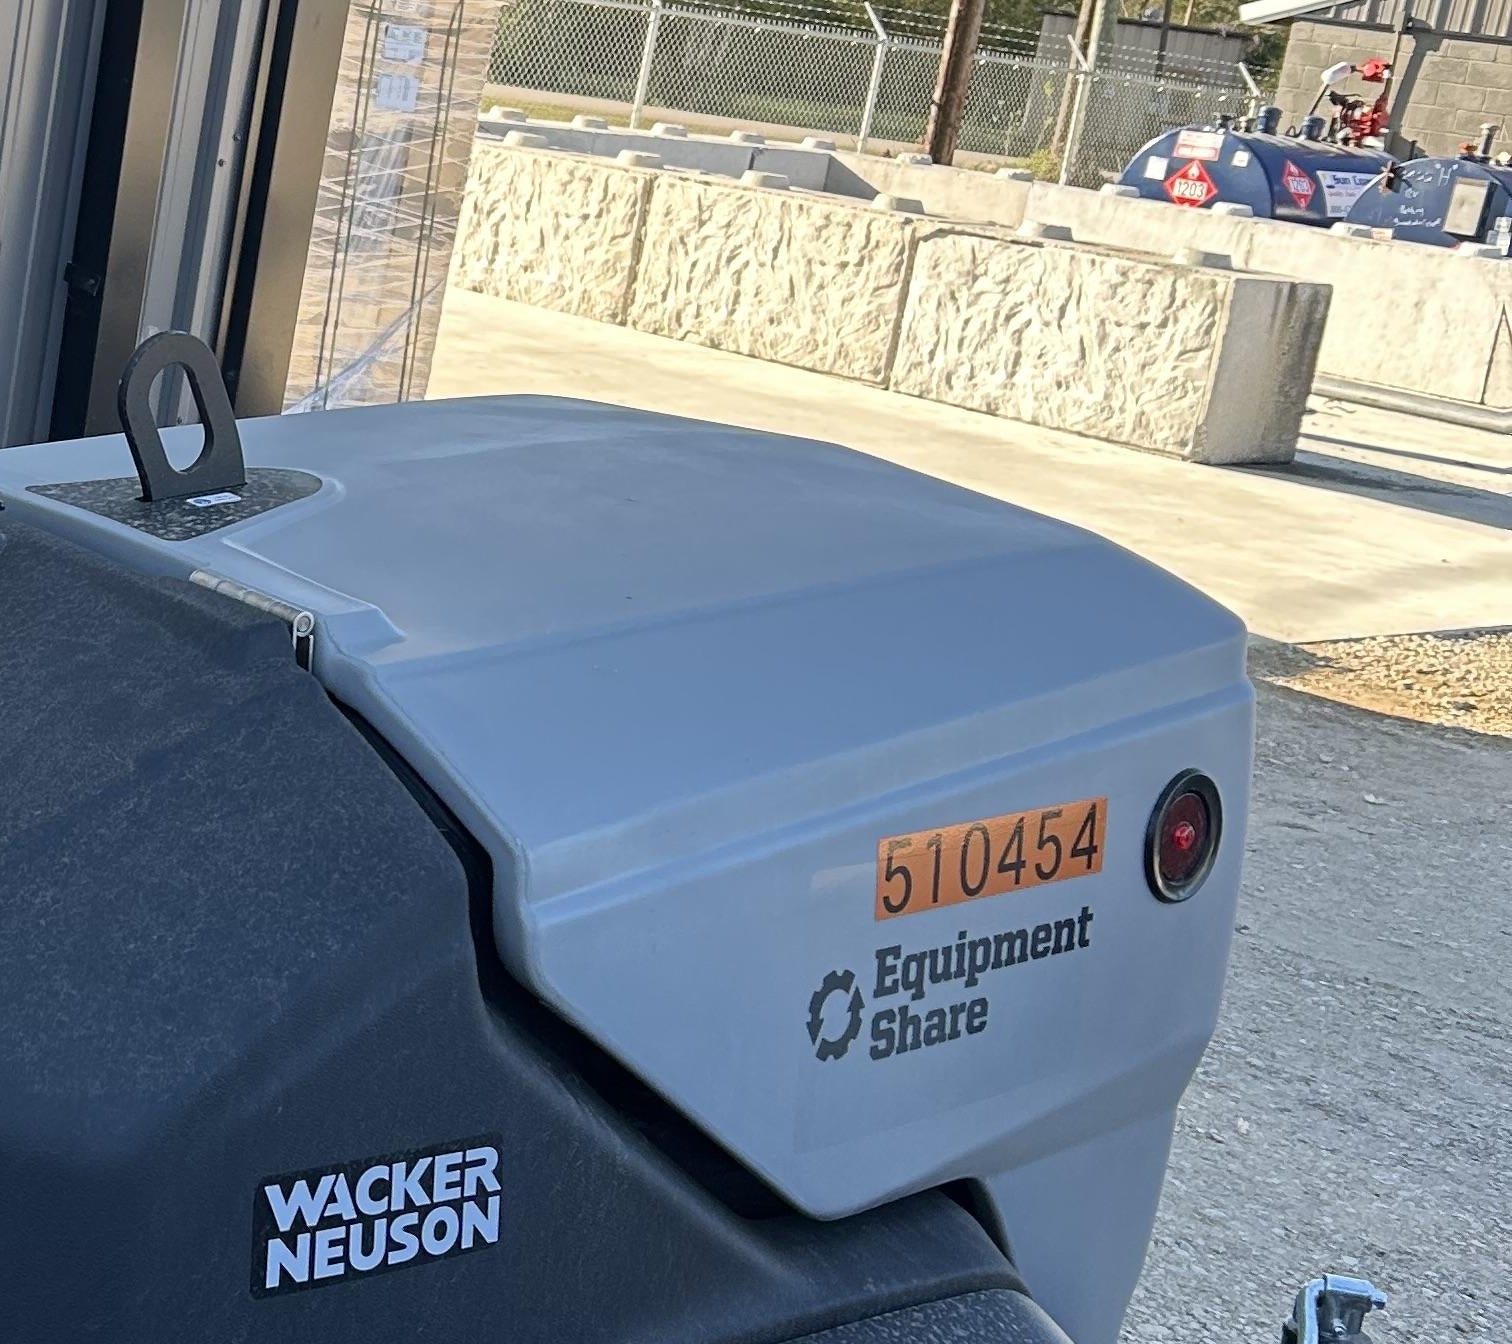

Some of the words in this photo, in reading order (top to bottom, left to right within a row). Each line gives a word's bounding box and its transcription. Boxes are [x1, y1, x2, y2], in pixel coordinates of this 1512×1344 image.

[1176, 181, 1205, 198] 1203
[881, 802, 1099, 915] 510454
[872, 906, 1094, 1001] Equipment
[869, 997, 989, 1061] Share
[265, 1146, 501, 1233] WACKER
[265, 1195, 501, 1289] NEUSON
